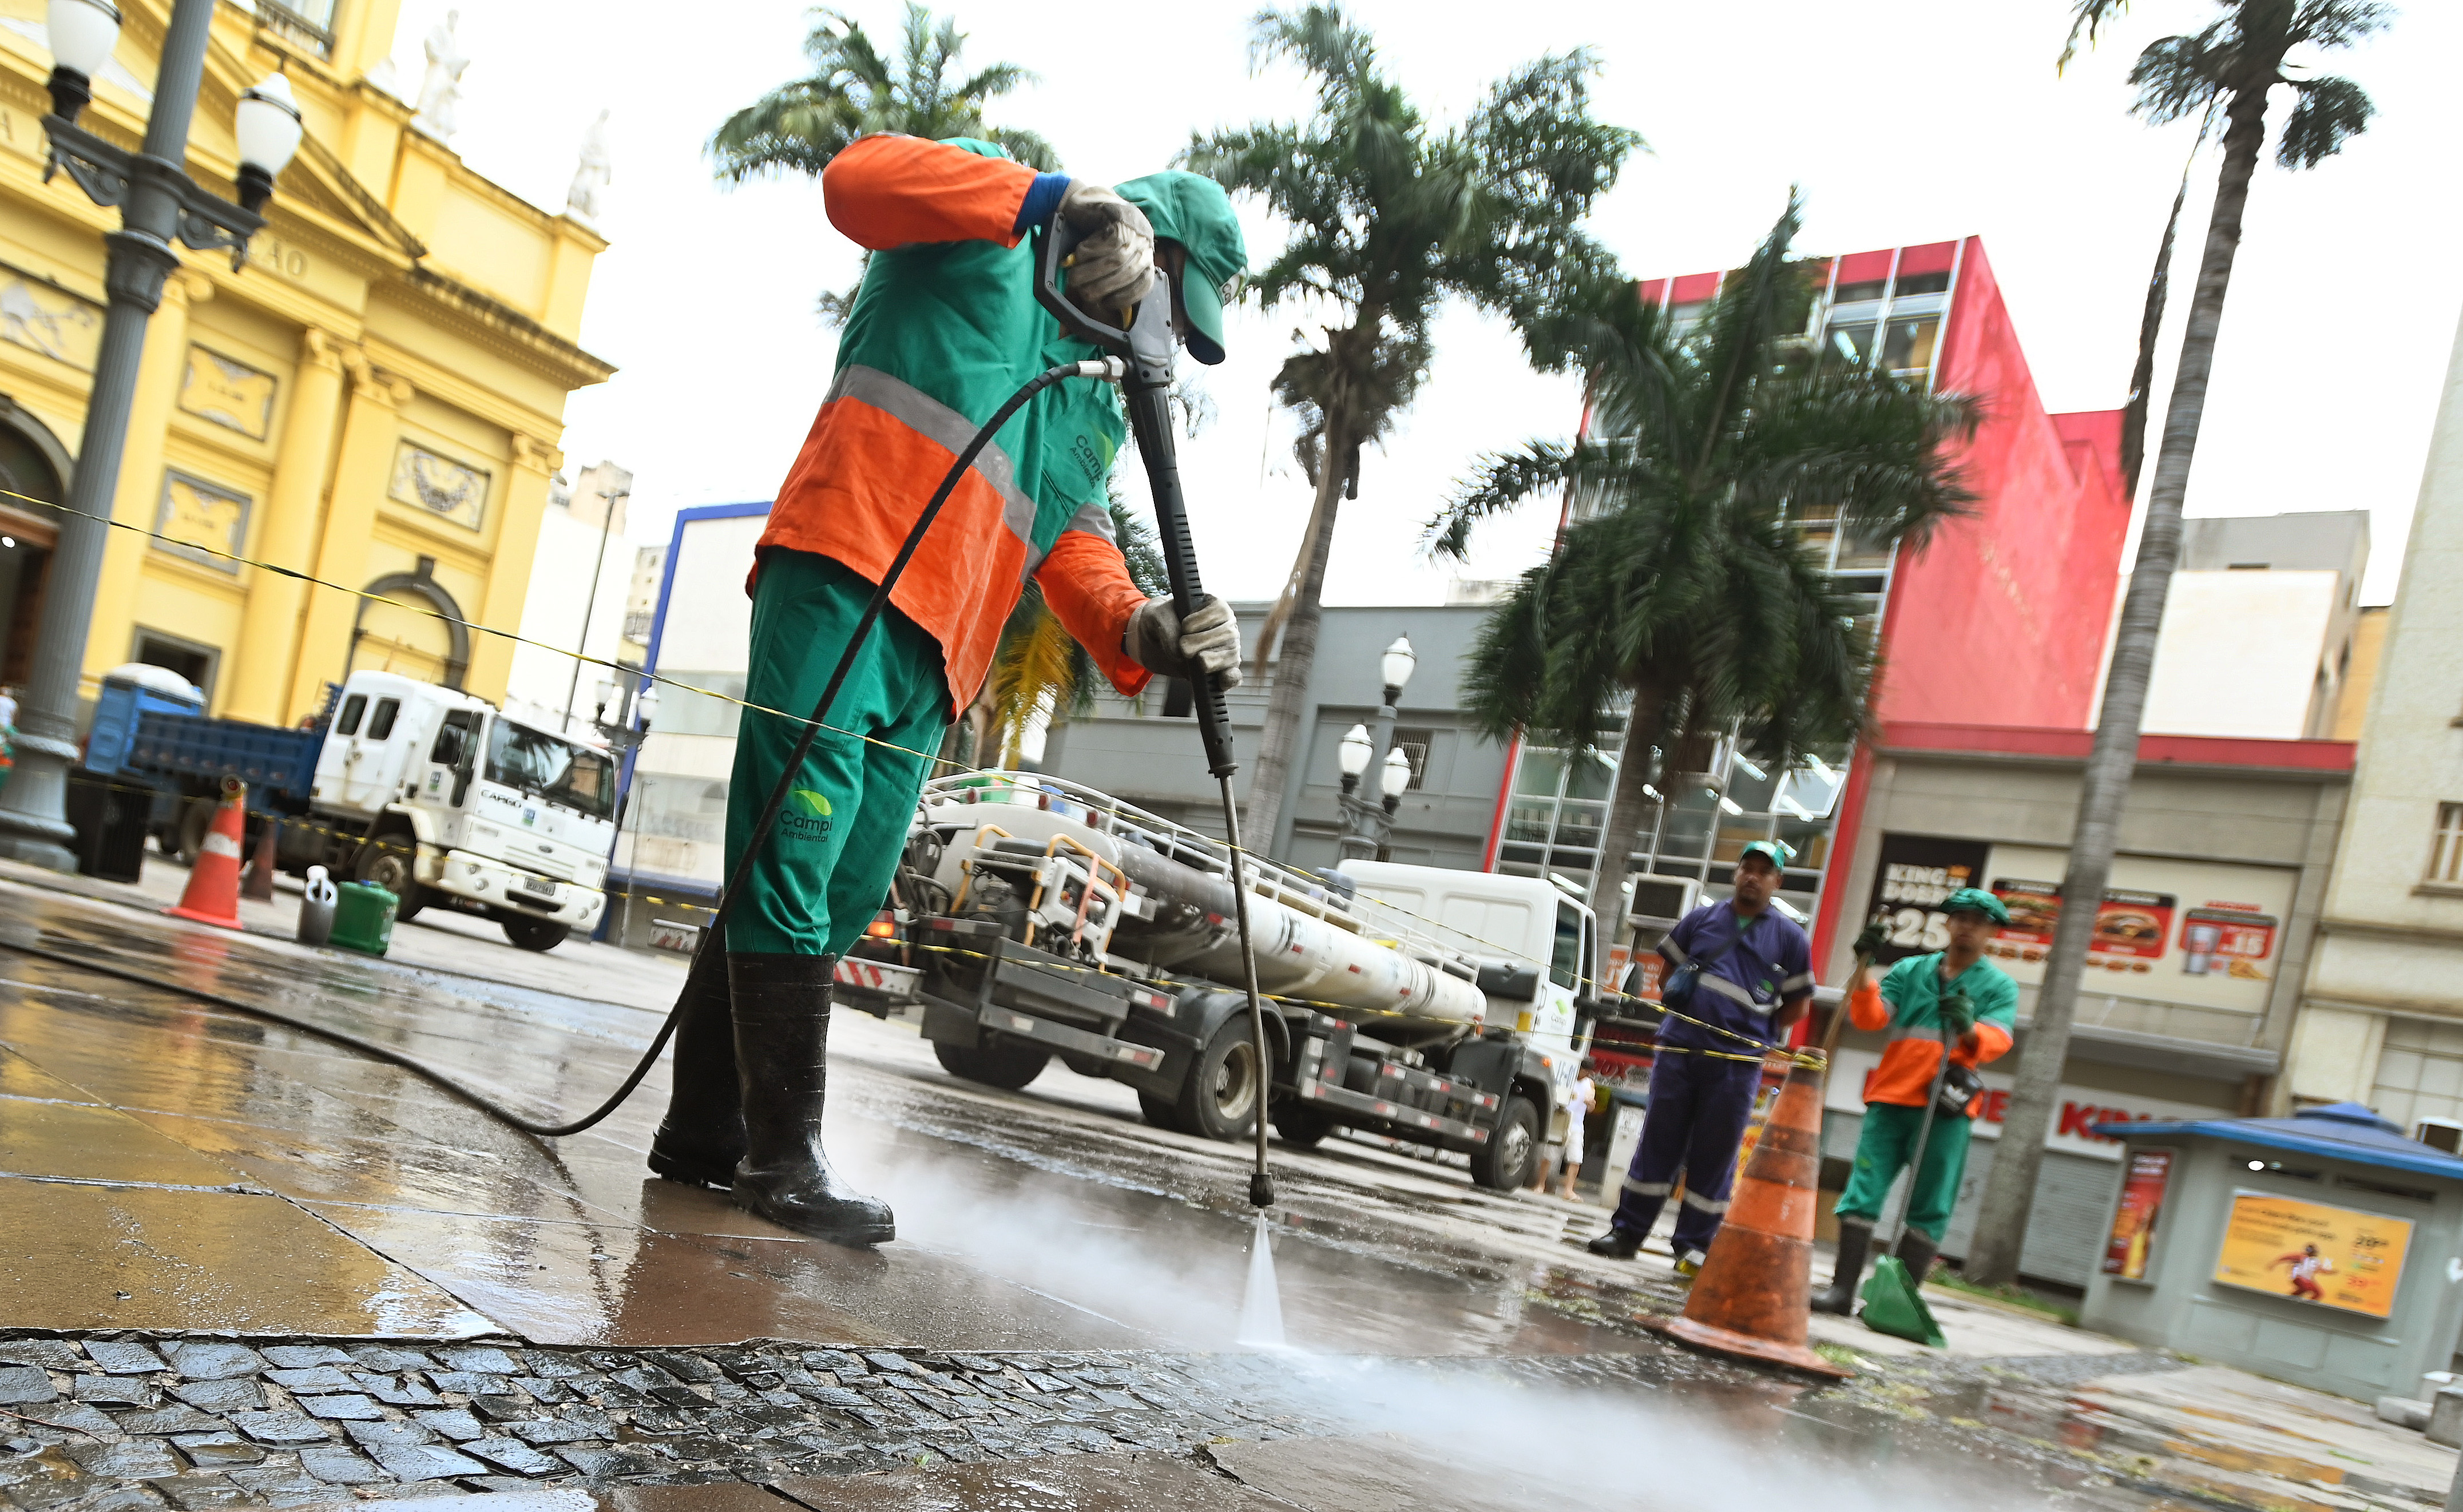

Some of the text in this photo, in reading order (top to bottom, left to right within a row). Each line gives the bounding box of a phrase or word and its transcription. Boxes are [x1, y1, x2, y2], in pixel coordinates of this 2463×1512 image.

[1076, 435, 1103, 482] Camp
[481, 789, 522, 808] CARGO
[780, 809, 833, 835] Campi
[780, 828, 828, 842] Ambiental
[1884, 862, 1948, 886] KING
[1890, 907, 1952, 952] 25
